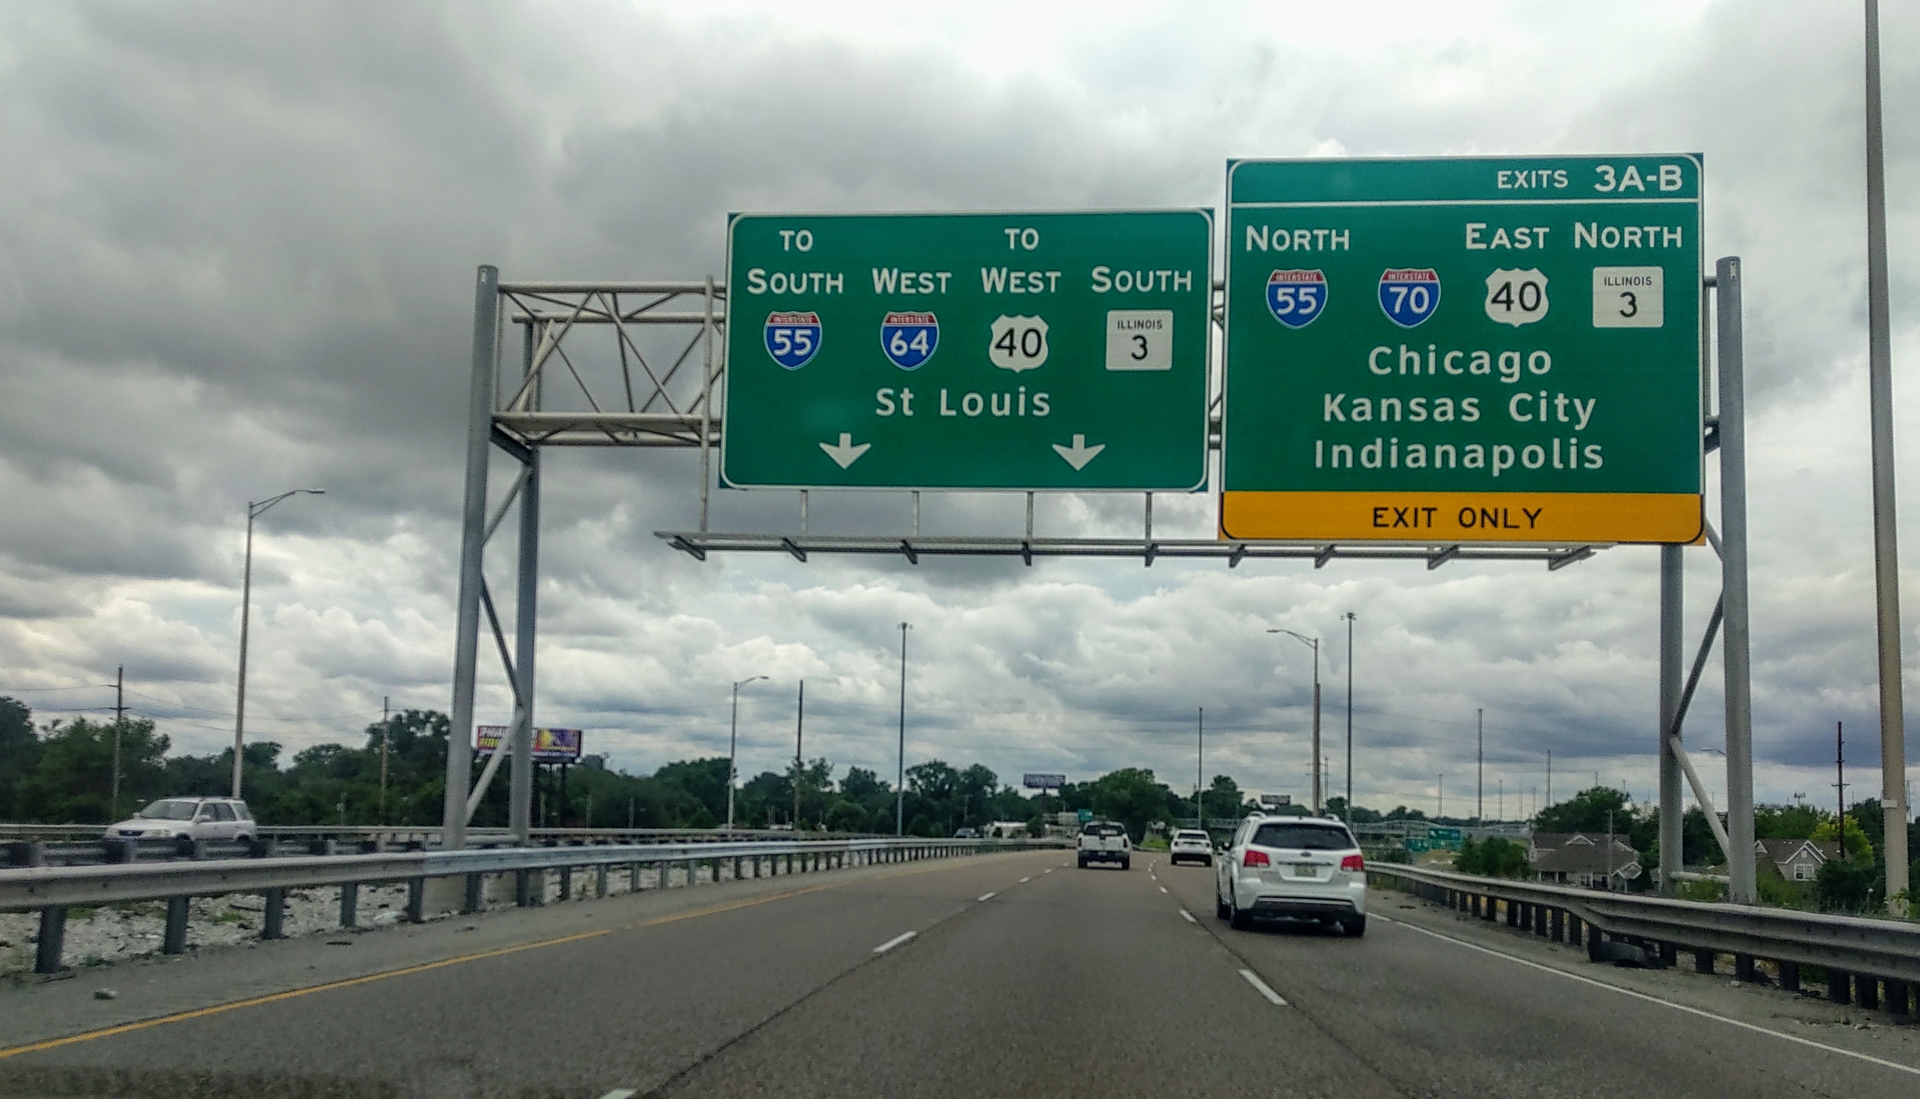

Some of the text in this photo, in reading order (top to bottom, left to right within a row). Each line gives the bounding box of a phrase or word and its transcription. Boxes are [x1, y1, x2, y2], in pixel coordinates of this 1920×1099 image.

[1498, 165, 1682, 192] EXITS 3A-B
[779, 230, 813, 251] TO
[1005, 228, 1039, 250] TO
[1246, 225, 1349, 251] NORTH
[1466, 223, 1549, 249] EAST
[1575, 222, 1682, 248] NORTH
[748, 268, 843, 294] SOUTH
[873, 268, 951, 293] WEST
[981, 267, 1061, 293] WEST
[1092, 266, 1191, 292] SOUTH
[1276, 273, 1317, 281] INTERSTATE
[1388, 272, 1430, 281] INTERSTATE
[1604, 276, 1652, 286] ILLINOIS
[1275, 288, 1319, 315] 55
[1389, 287, 1429, 313] 70
[1491, 281, 1541, 311] 40
[1620, 292, 1637, 317] 3
[773, 315, 813, 323] INTERSTATE
[890, 315, 930, 323] INTERSTATE
[1118, 319, 1162, 330] ILLINOIS
[772, 329, 814, 357] 55
[889, 330, 930, 357] 64
[995, 328, 1042, 358] 40
[1131, 335, 1148, 360] 3
[1369, 344, 1551, 383] Chicago
[876, 386, 1050, 416] St Louis
[1324, 391, 1596, 430] Kansas City
[1316, 438, 1603, 476] Indianapolis
[1373, 507, 1541, 528] EXIT ONLY
